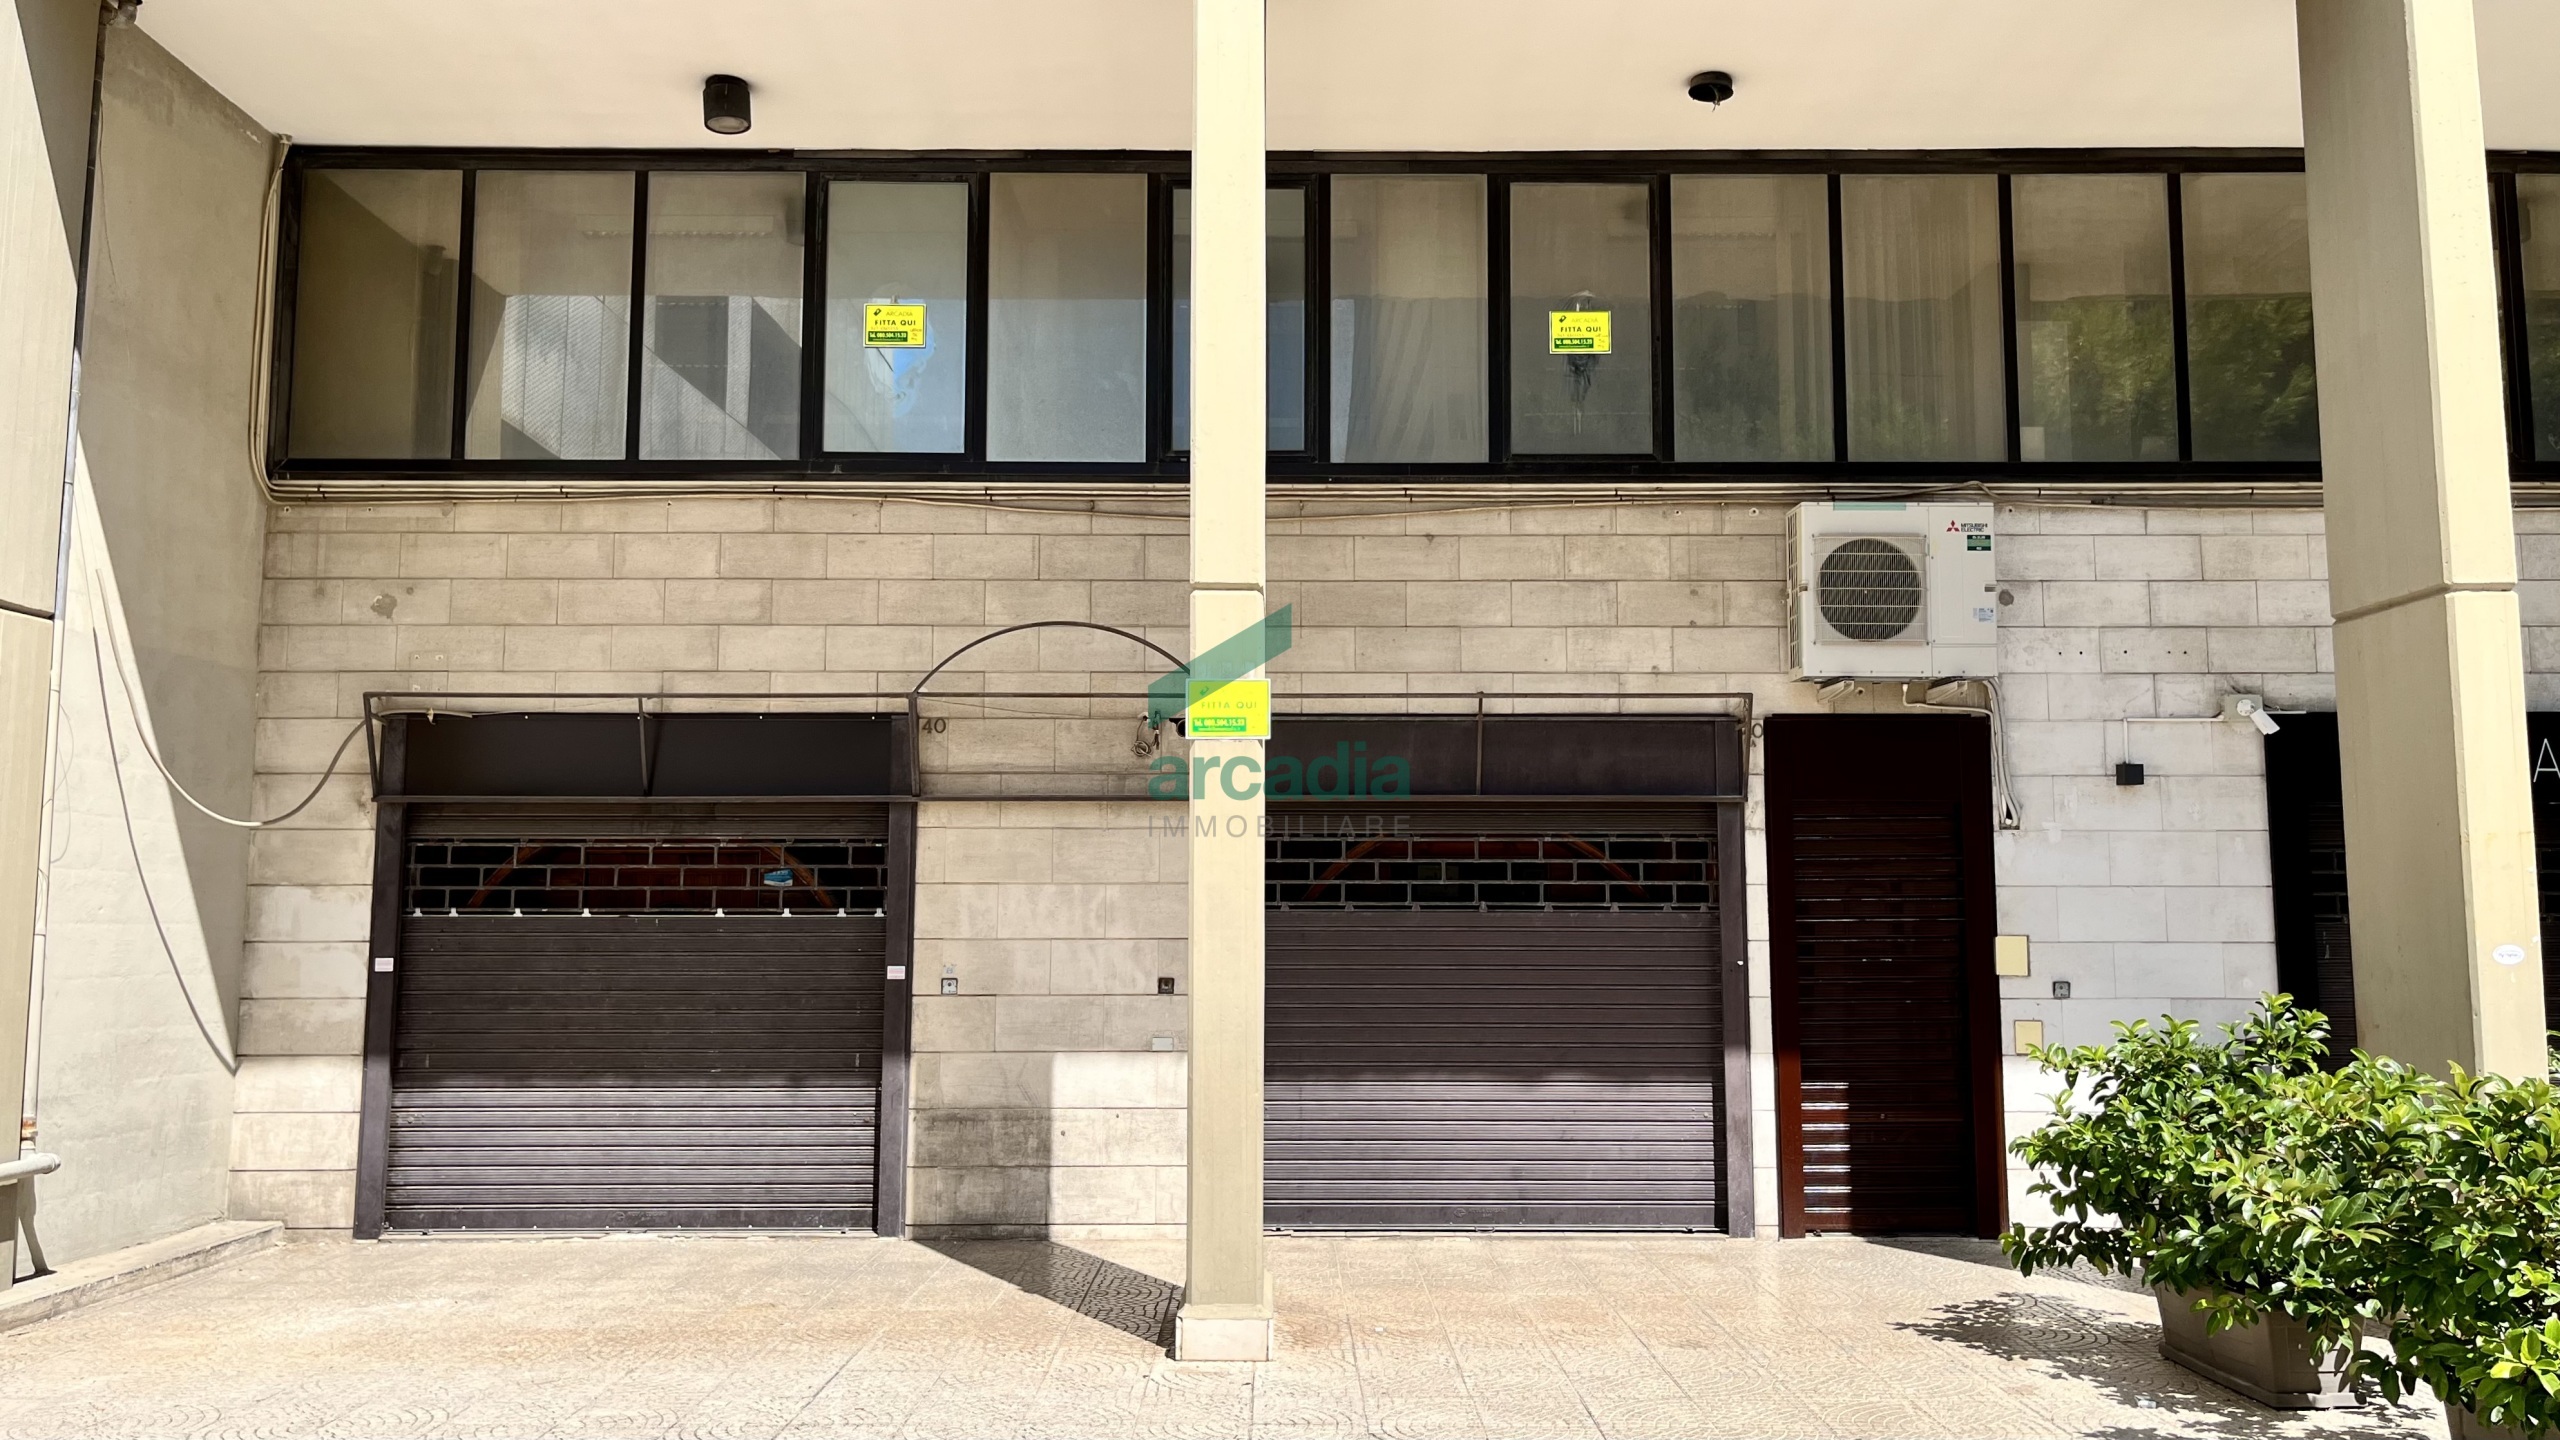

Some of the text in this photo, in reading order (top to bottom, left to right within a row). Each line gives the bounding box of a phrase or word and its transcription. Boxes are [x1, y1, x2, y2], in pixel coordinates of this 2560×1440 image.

[1201, 701, 1257, 709] FITTA QUI
[921, 717, 947, 734] 40
